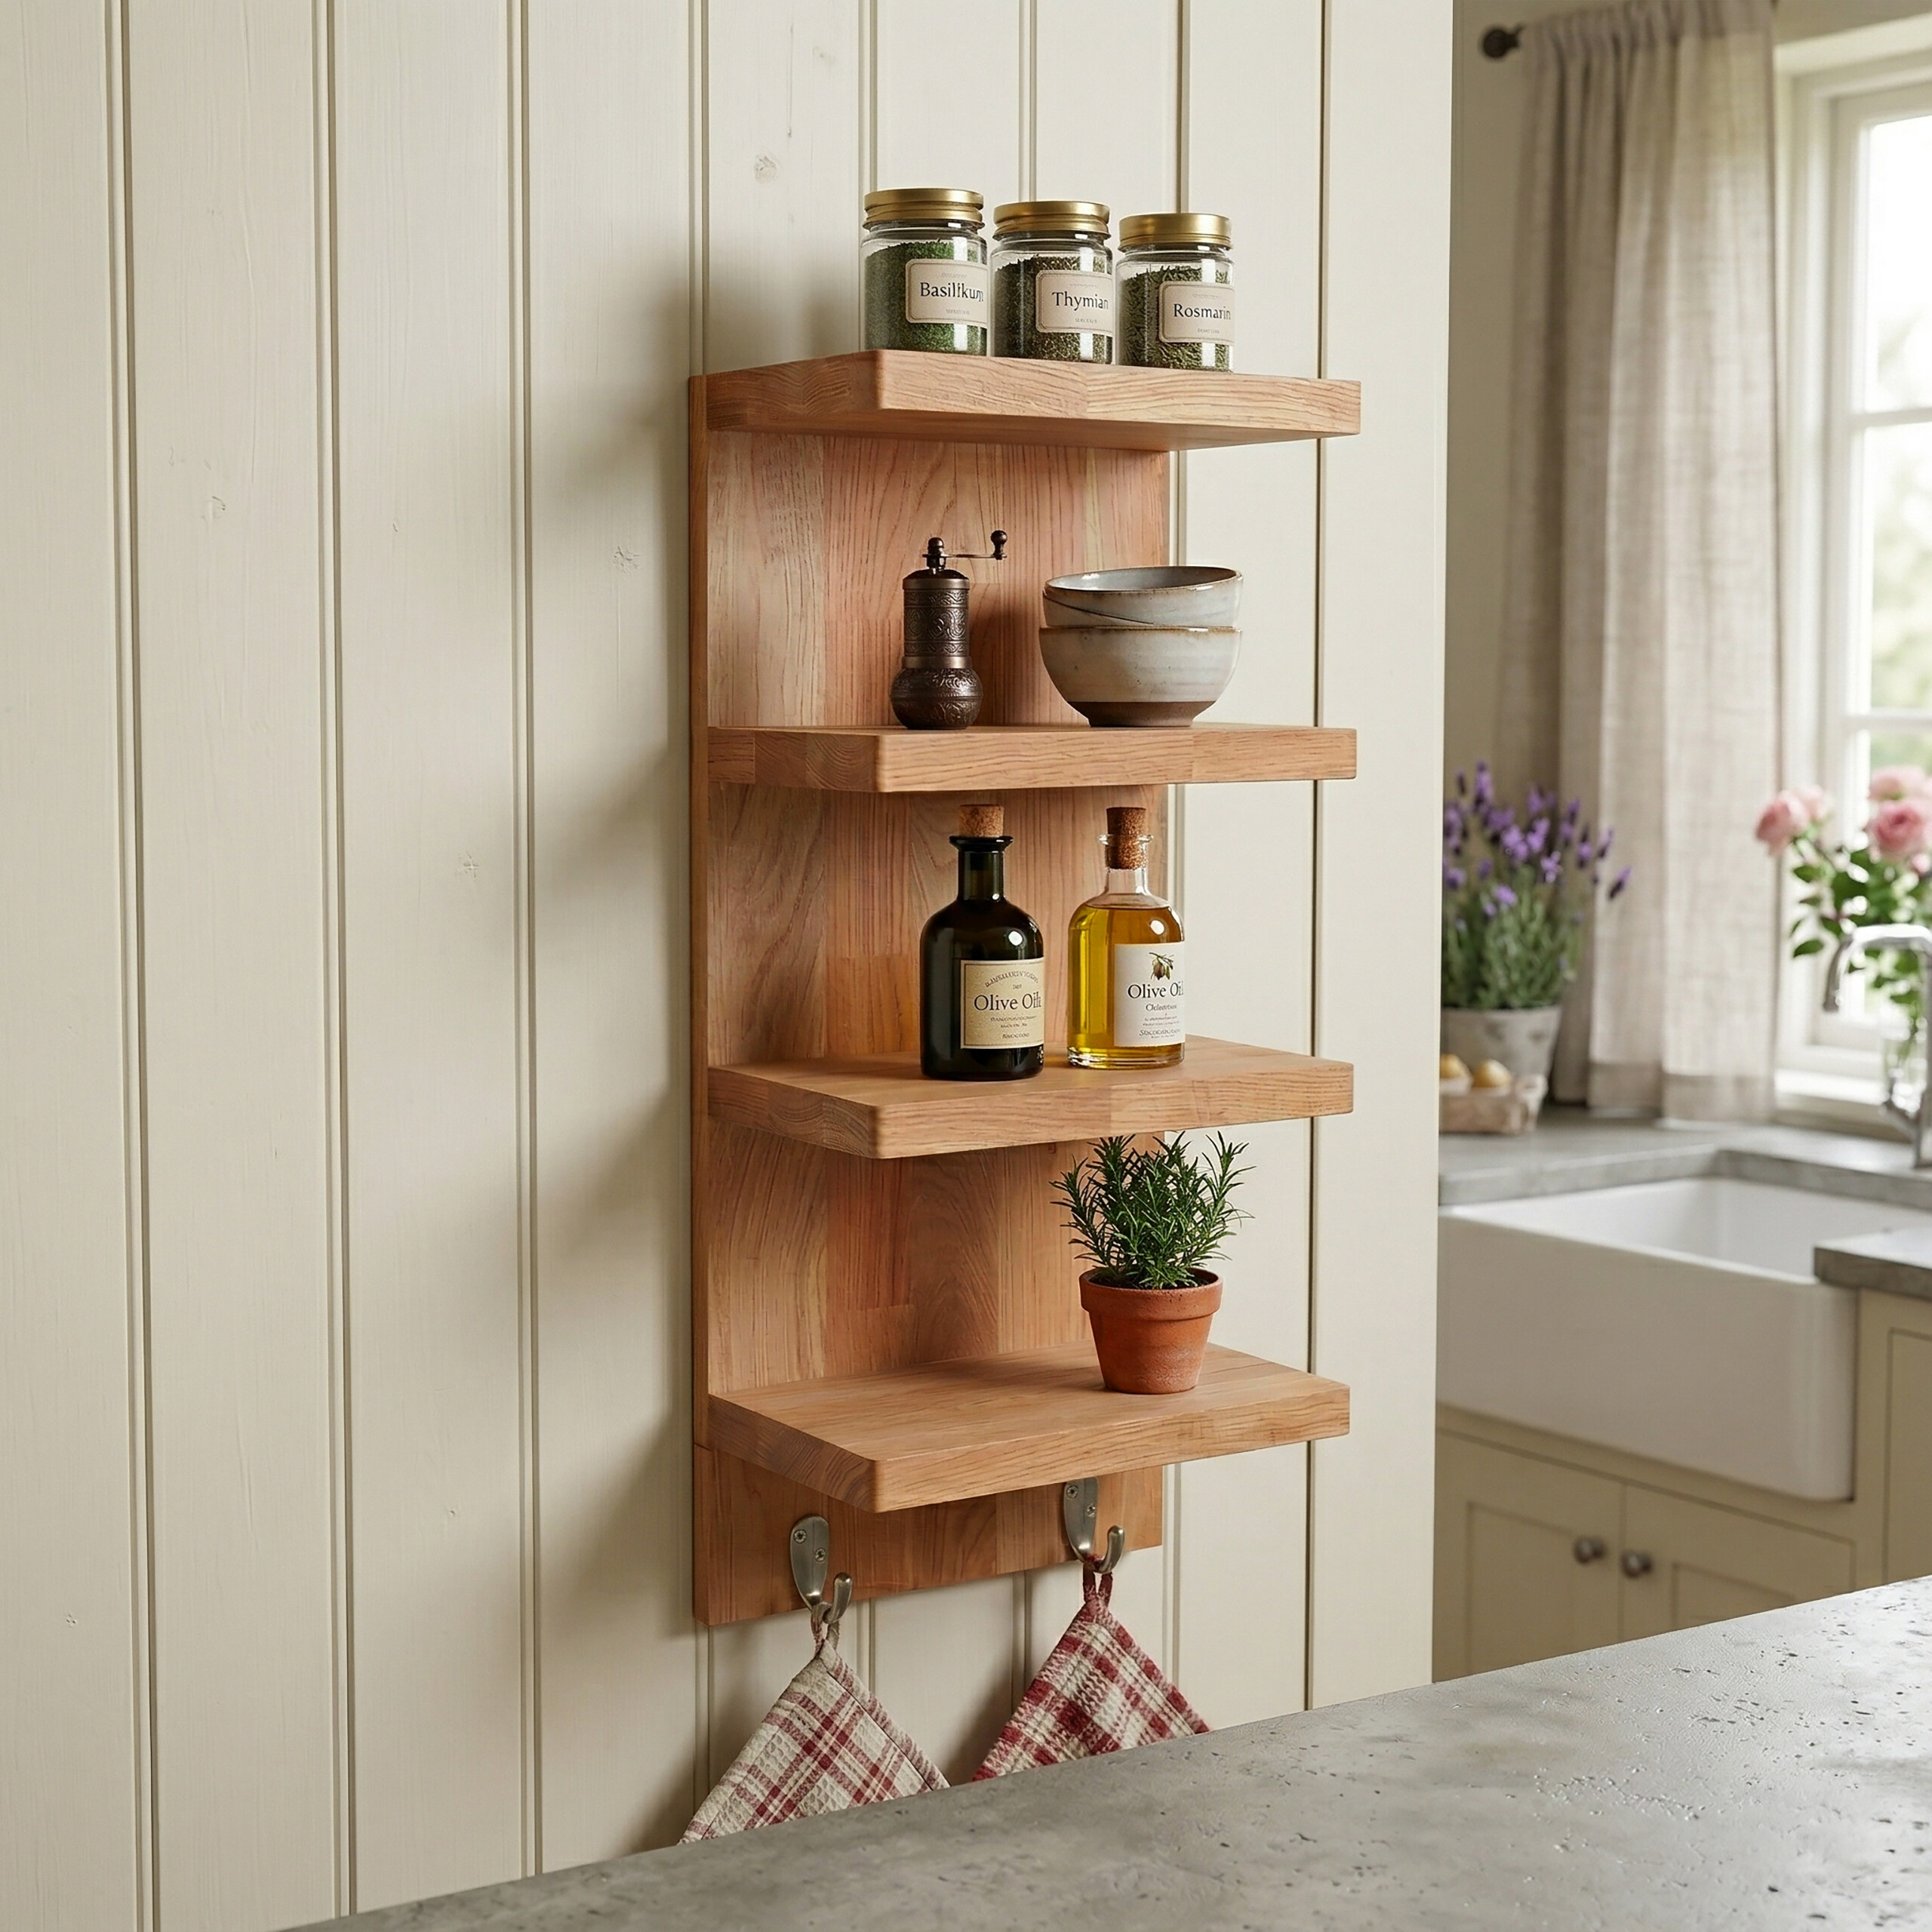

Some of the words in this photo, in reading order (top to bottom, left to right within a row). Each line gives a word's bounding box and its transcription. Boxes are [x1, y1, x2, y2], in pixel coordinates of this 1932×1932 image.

[1051, 291, 1109, 311] Thymian
[1174, 303, 1231, 320] Rosmarin
[1128, 983, 1167, 998] Olive
[974, 994, 1018, 1011] Olive
